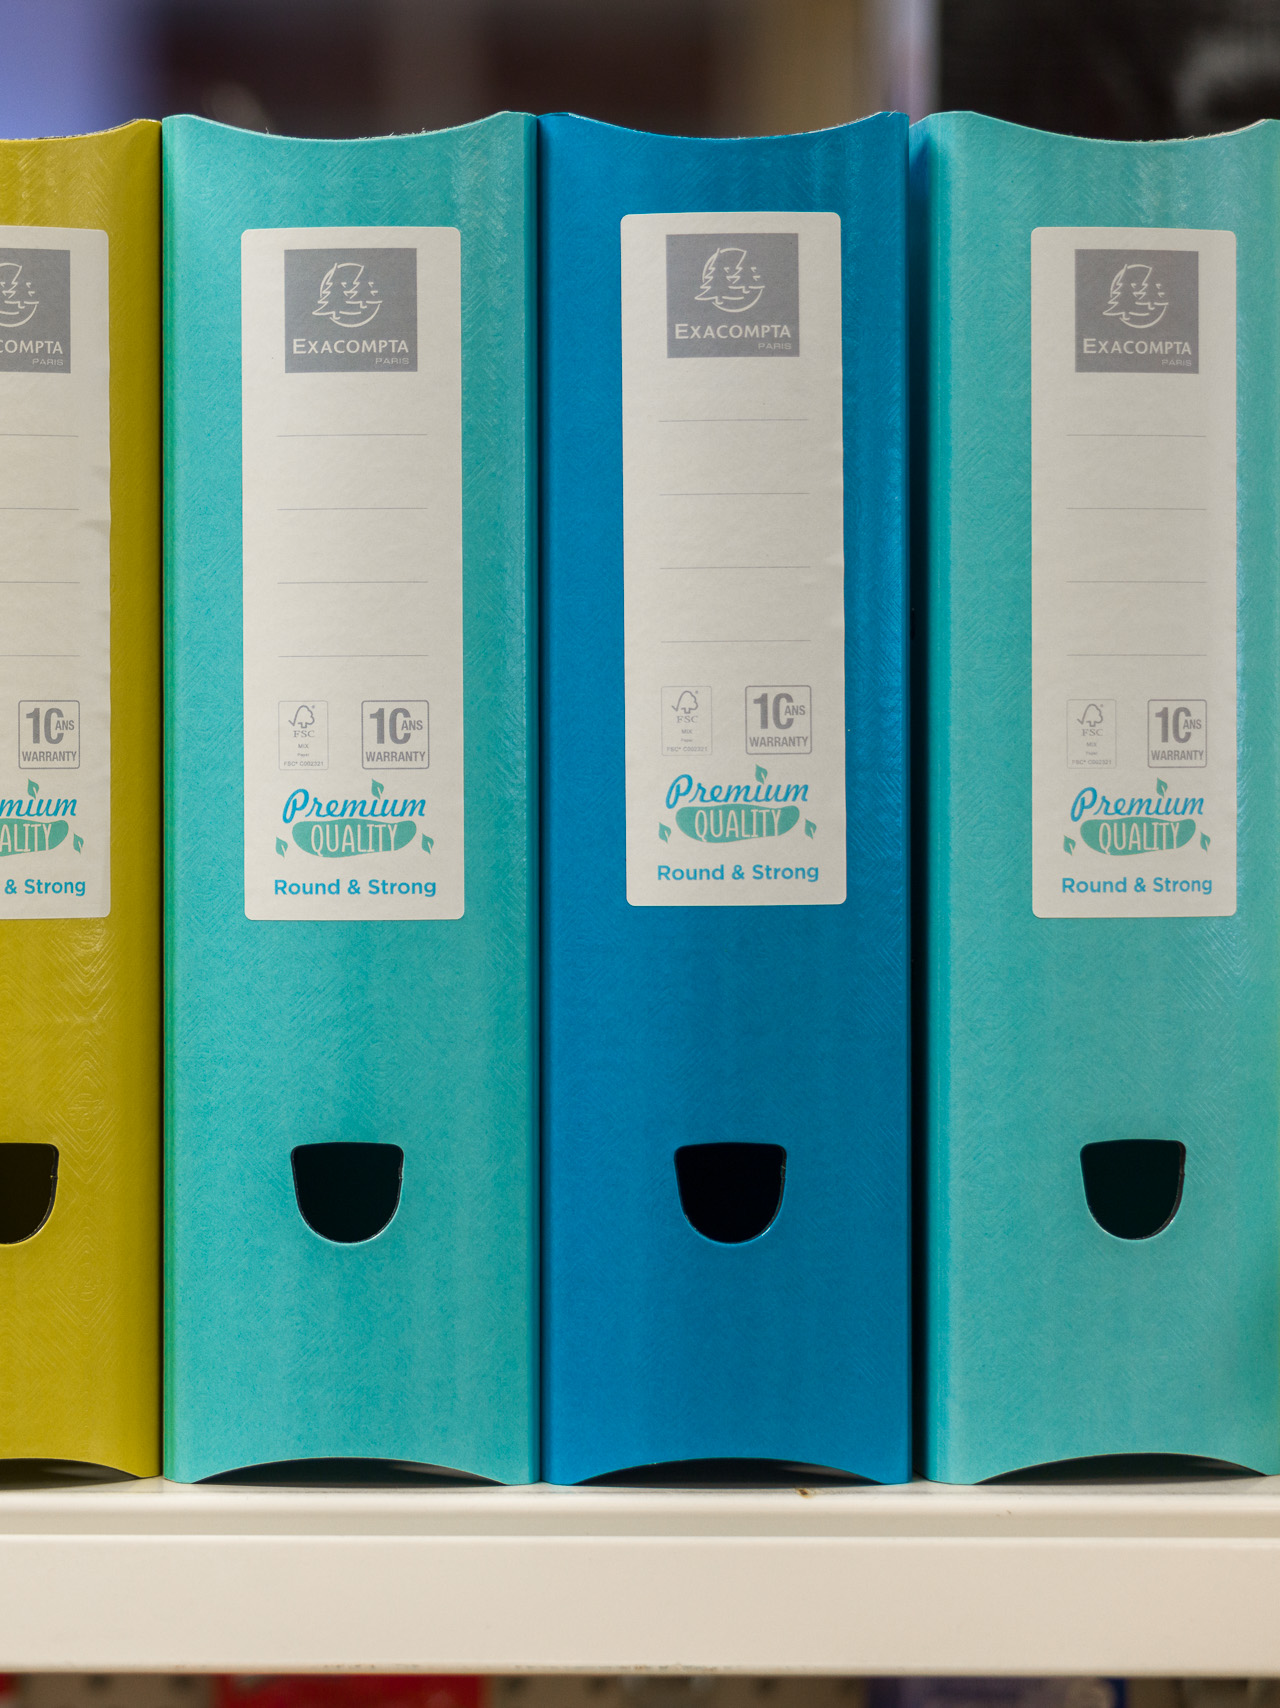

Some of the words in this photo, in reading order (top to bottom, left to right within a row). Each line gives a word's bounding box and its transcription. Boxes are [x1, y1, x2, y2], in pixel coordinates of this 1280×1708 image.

[675, 323, 791, 339] EXACOMPTA
[293, 338, 409, 354] EXACOMPTA
[1083, 338, 1191, 355] EXACOMPTA
[33, 358, 64, 366] PARIS
[784, 705, 805, 715] ANS
[55, 720, 74, 730] ANS
[401, 720, 423, 730] ANS
[1183, 719, 1201, 729] ANS
[293, 730, 315, 738] FSC
[749, 736, 808, 747] WARRANTY
[22, 751, 76, 762] WARRANTY
[366, 751, 425, 762] WARRANTY
[1151, 750, 1204, 760] WARRANTY
[666, 774, 808, 809] Premium
[282, 789, 426, 823] Premium
[1071, 787, 1204, 822] Premium
[695, 809, 781, 842] QUALITY
[311, 824, 397, 857] QUALITY
[1099, 823, 1179, 855] QUALITY
[658, 865, 724, 880] Round
[732, 865, 744, 880] &
[752, 865, 818, 882] Strong
[4, 879, 17, 894] &
[24, 879, 86, 896] Strong
[274, 879, 340, 895] Round
[348, 879, 360, 894] &
[368, 879, 436, 897] Strong
[1062, 877, 1127, 893] Round
[1134, 877, 1146, 892] &
[1153, 877, 1212, 894] Strong
